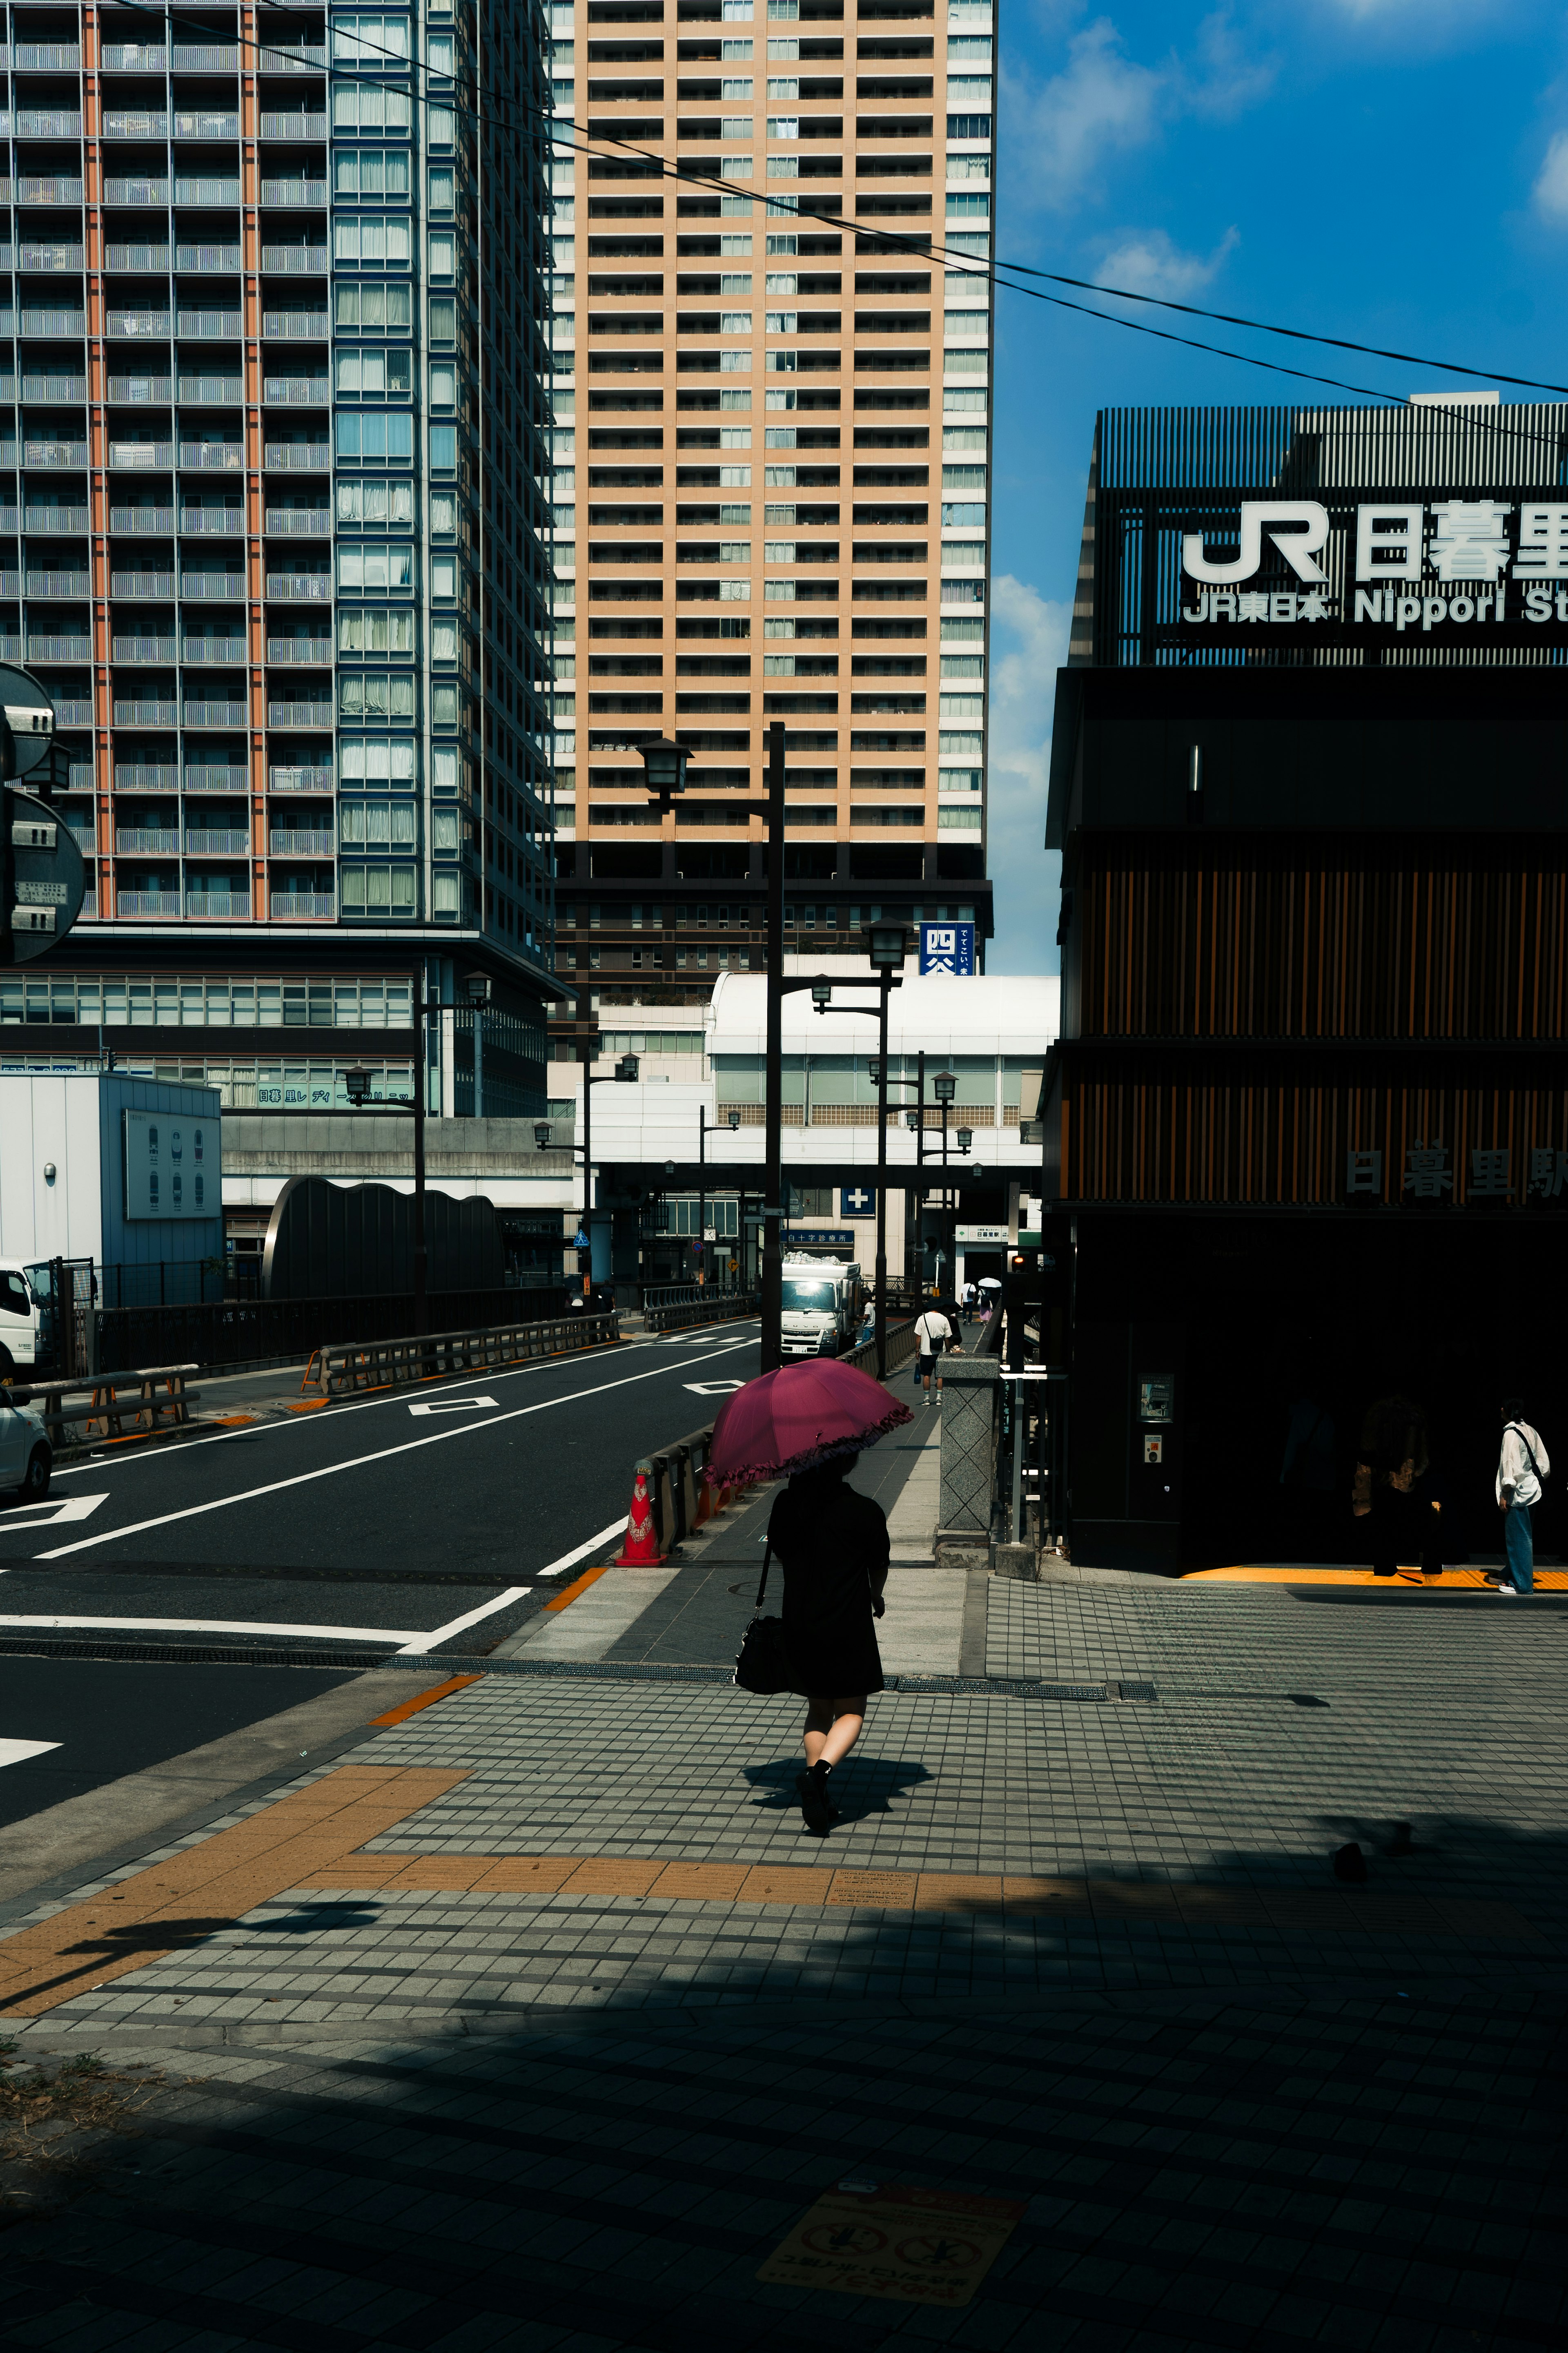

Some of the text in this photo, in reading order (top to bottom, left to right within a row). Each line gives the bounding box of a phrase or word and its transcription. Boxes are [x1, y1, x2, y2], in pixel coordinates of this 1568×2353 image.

[1183, 501, 1330, 584] JR
[1183, 591, 1328, 623] JR東日本
[1354, 588, 1568, 631] Nippori St
[1346, 1138, 1568, 1198] 日暮里駅
